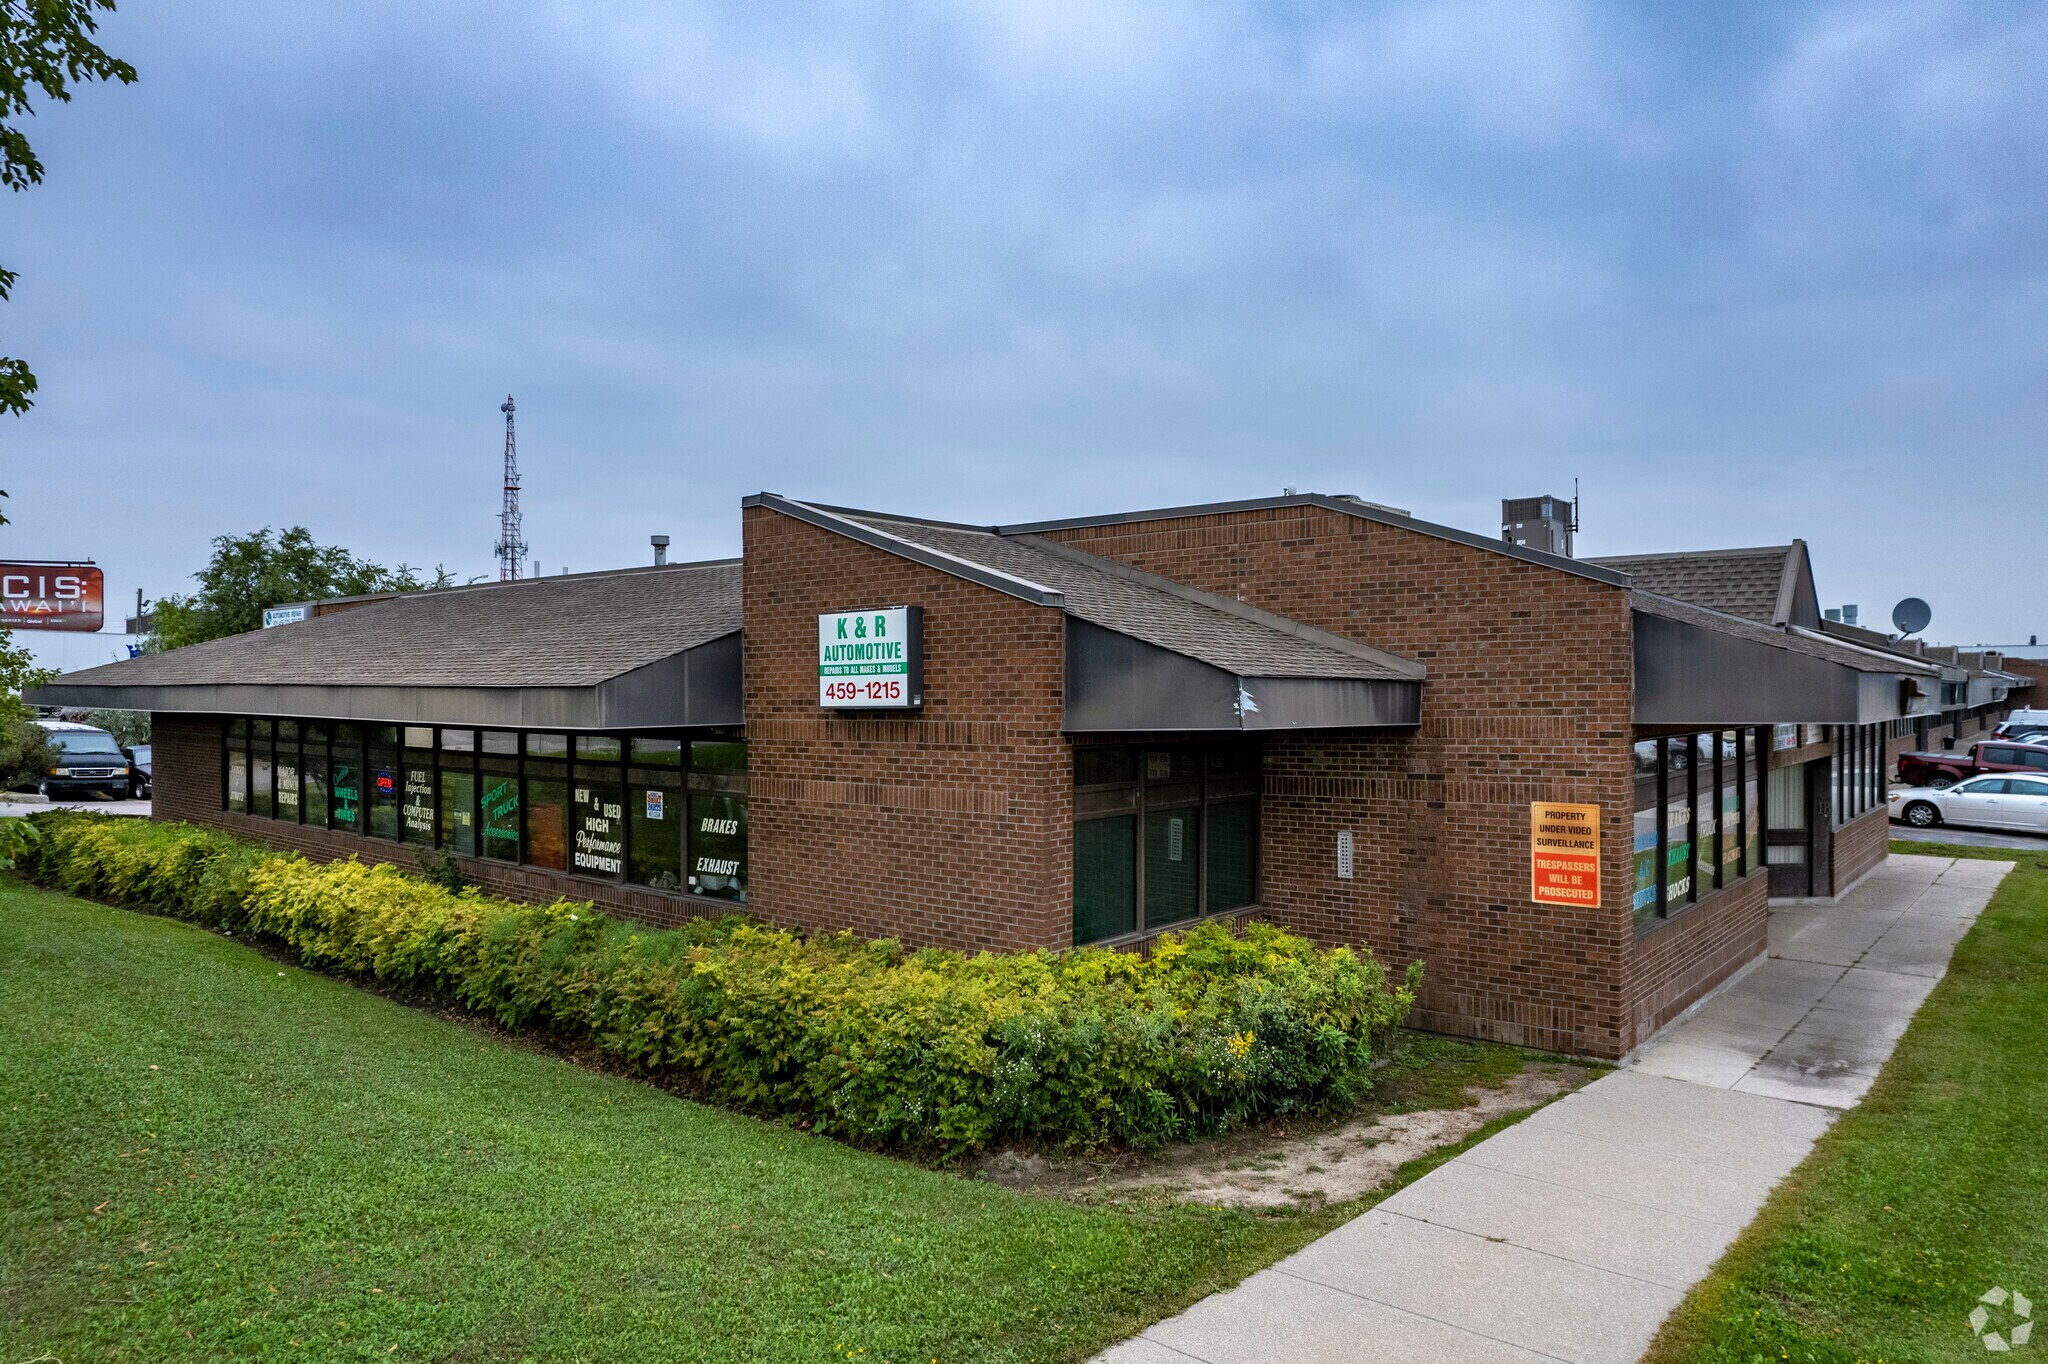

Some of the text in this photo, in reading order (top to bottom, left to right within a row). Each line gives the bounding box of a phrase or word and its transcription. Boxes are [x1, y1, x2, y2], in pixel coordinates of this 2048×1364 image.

[837, 615, 886, 639] K & R
[824, 642, 901, 661] AUTOMOTIVE
[824, 666, 842, 674] REPAIRS
[883, 664, 901, 672] MODELS
[826, 682, 900, 699] 459-1215
[377, 777, 392, 788] OPEN
[411, 771, 425, 783] FUEL
[334, 787, 358, 801] WHEELS
[405, 781, 431, 795] Injection
[481, 781, 507, 809] SPORT
[278, 792, 298, 805] REPAIRS
[415, 795, 421, 806] &
[575, 788, 589, 804] NEW
[344, 799, 348, 809] &
[403, 803, 434, 820] COMPUTER
[492, 794, 519, 820] TRUCK
[594, 797, 599, 811] &
[604, 803, 621, 819] USED
[1818, 800, 1830, 815] 18
[1545, 811, 1586, 820] PROPERTY
[406, 816, 431, 831] Analysis
[585, 817, 609, 833] HIGH
[700, 817, 738, 836] BRAKES
[1540, 825, 1591, 835] UNDER VIDEO
[481, 821, 519, 842] Accessories
[576, 830, 621, 854] Performance
[1537, 838, 1594, 849] SURVEILLANCE
[575, 852, 621, 874] EQUIPMENT
[696, 857, 740, 876] EXHAUST
[1536, 859, 1595, 872] TRESPASSERS
[1549, 874, 1582, 885] WILL BE
[1539, 886, 1593, 899] PROSECUTED
